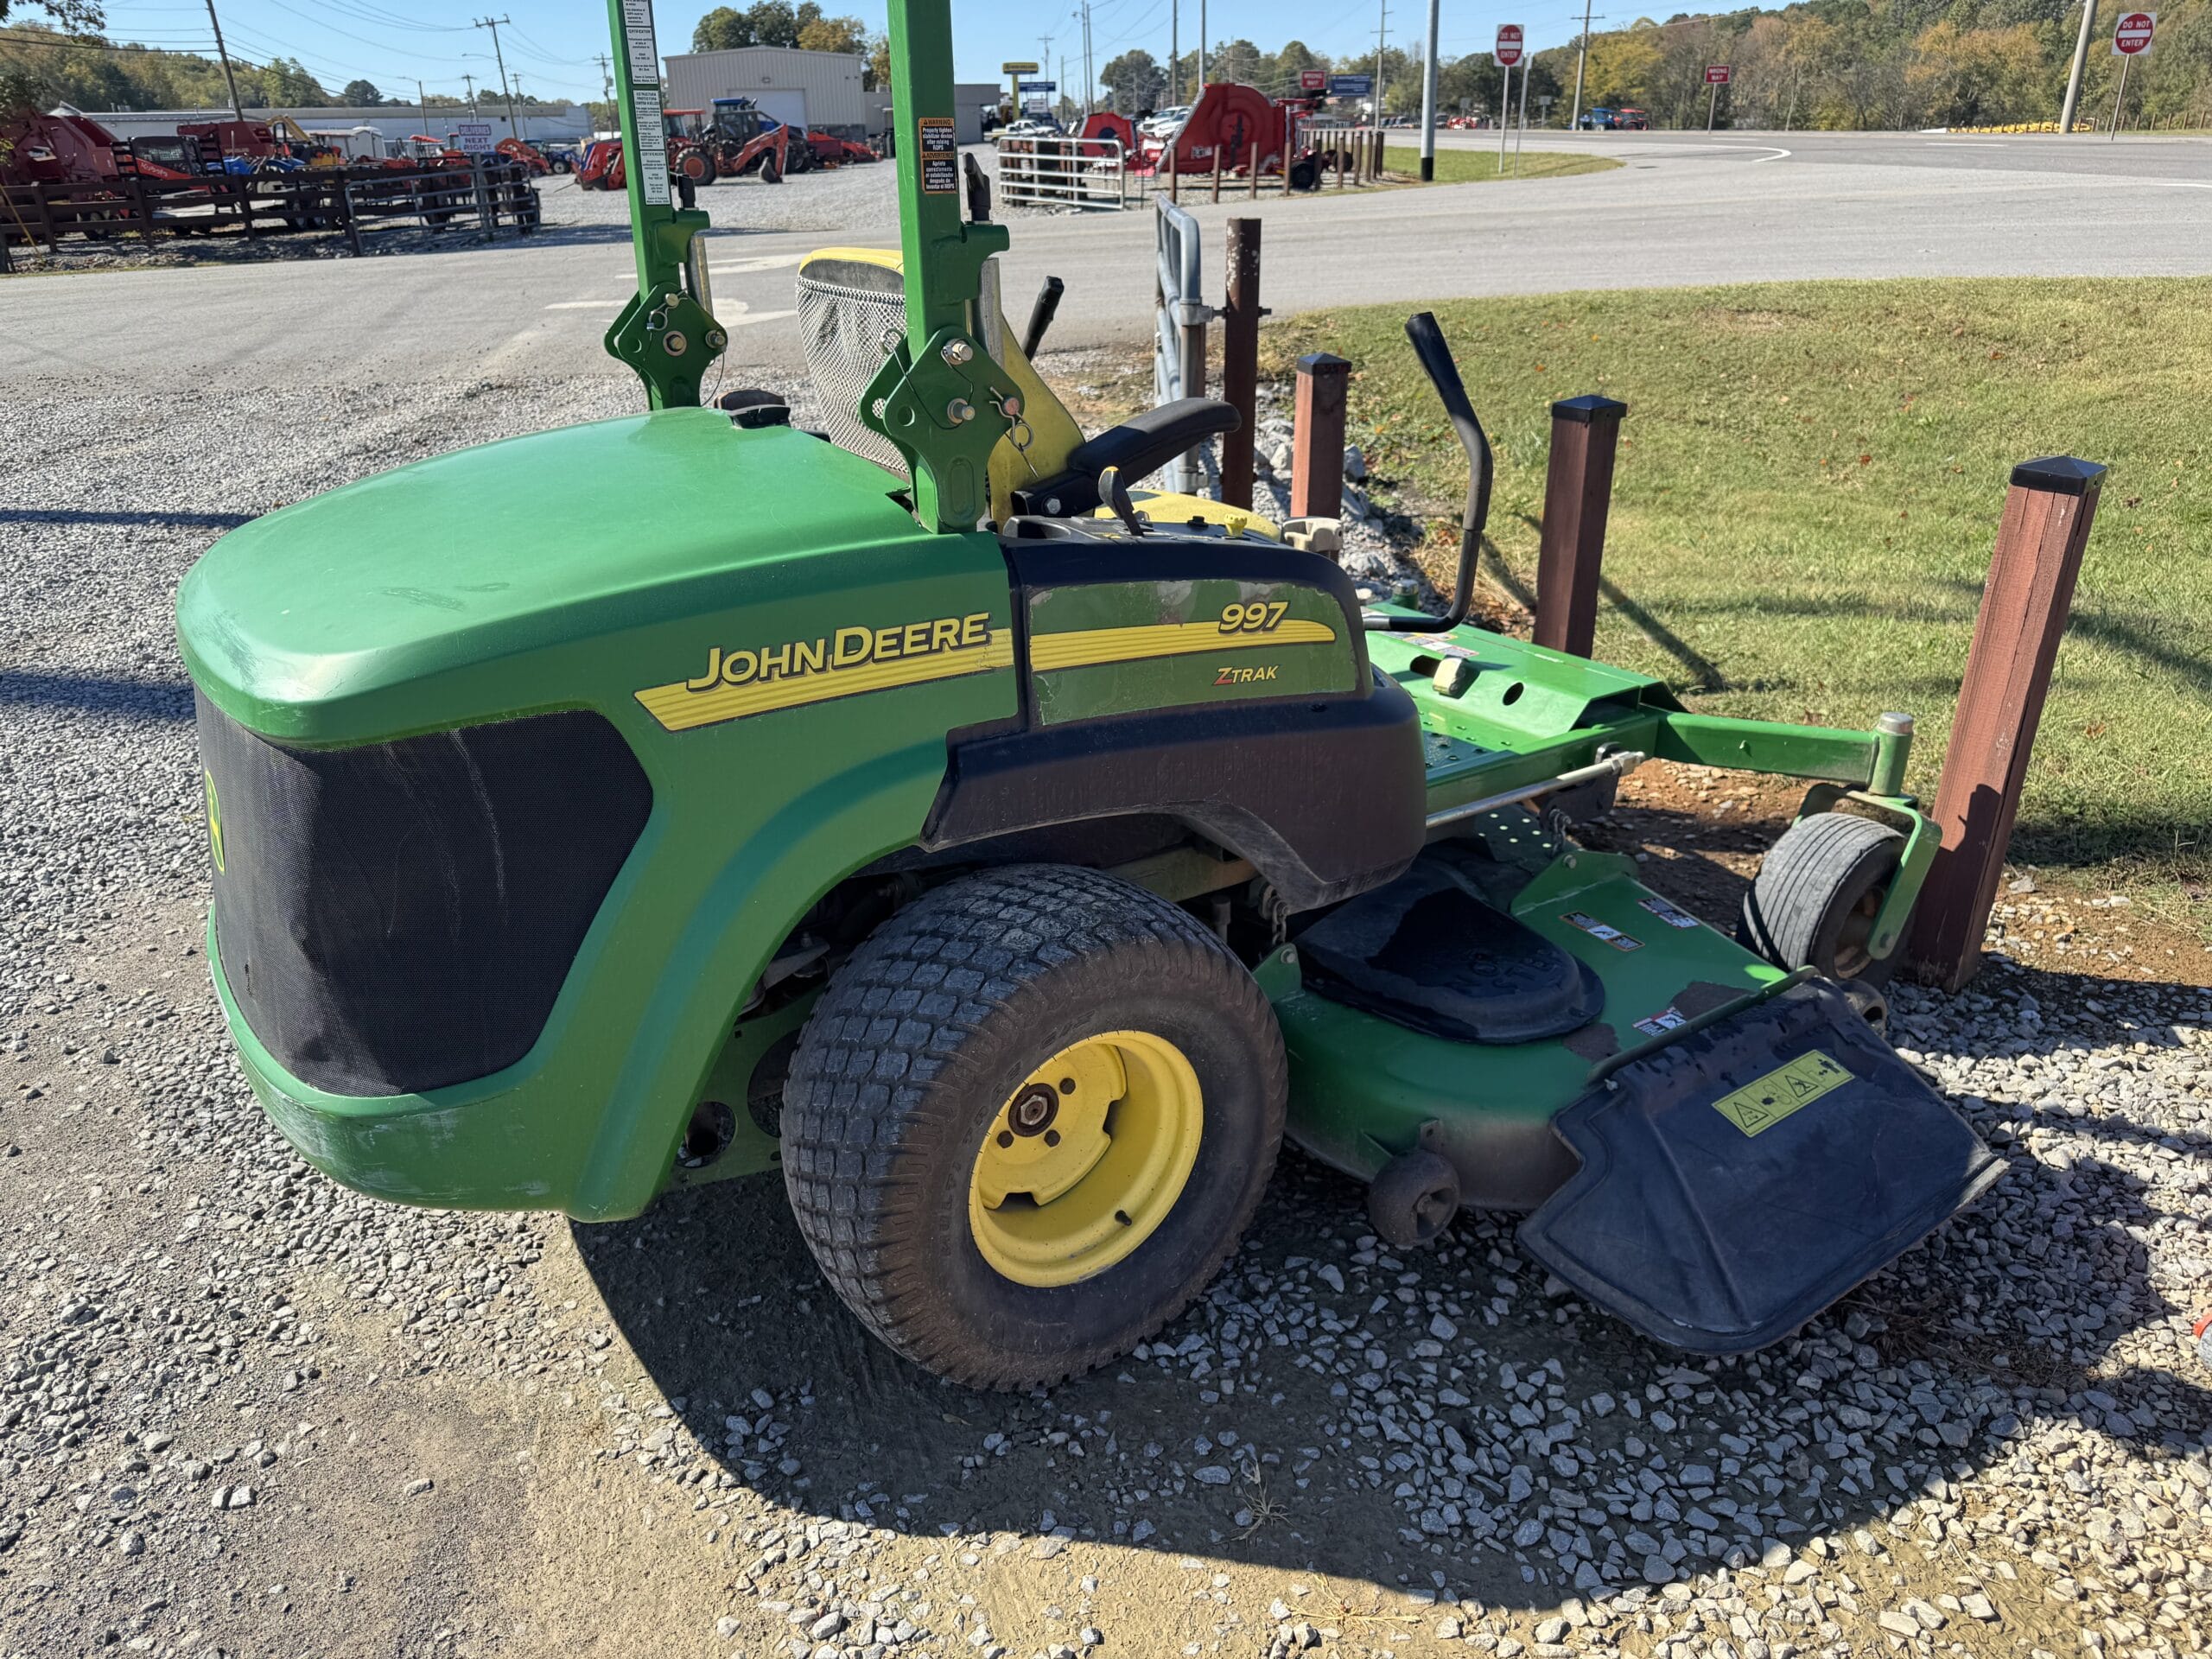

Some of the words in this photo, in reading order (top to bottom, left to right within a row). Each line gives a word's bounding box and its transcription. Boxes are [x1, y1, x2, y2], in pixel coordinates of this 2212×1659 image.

[2136, 20, 2150, 29] NOT
[1510, 31, 1520, 40] NOT
[1500, 50, 1518, 59] ENTER
[141, 162, 168, 177] Kubota
[1218, 601, 1289, 632] 997
[686, 638, 827, 690] JOHN
[832, 612, 990, 668] DEERE
[1213, 664, 1280, 685] ZTRAK
